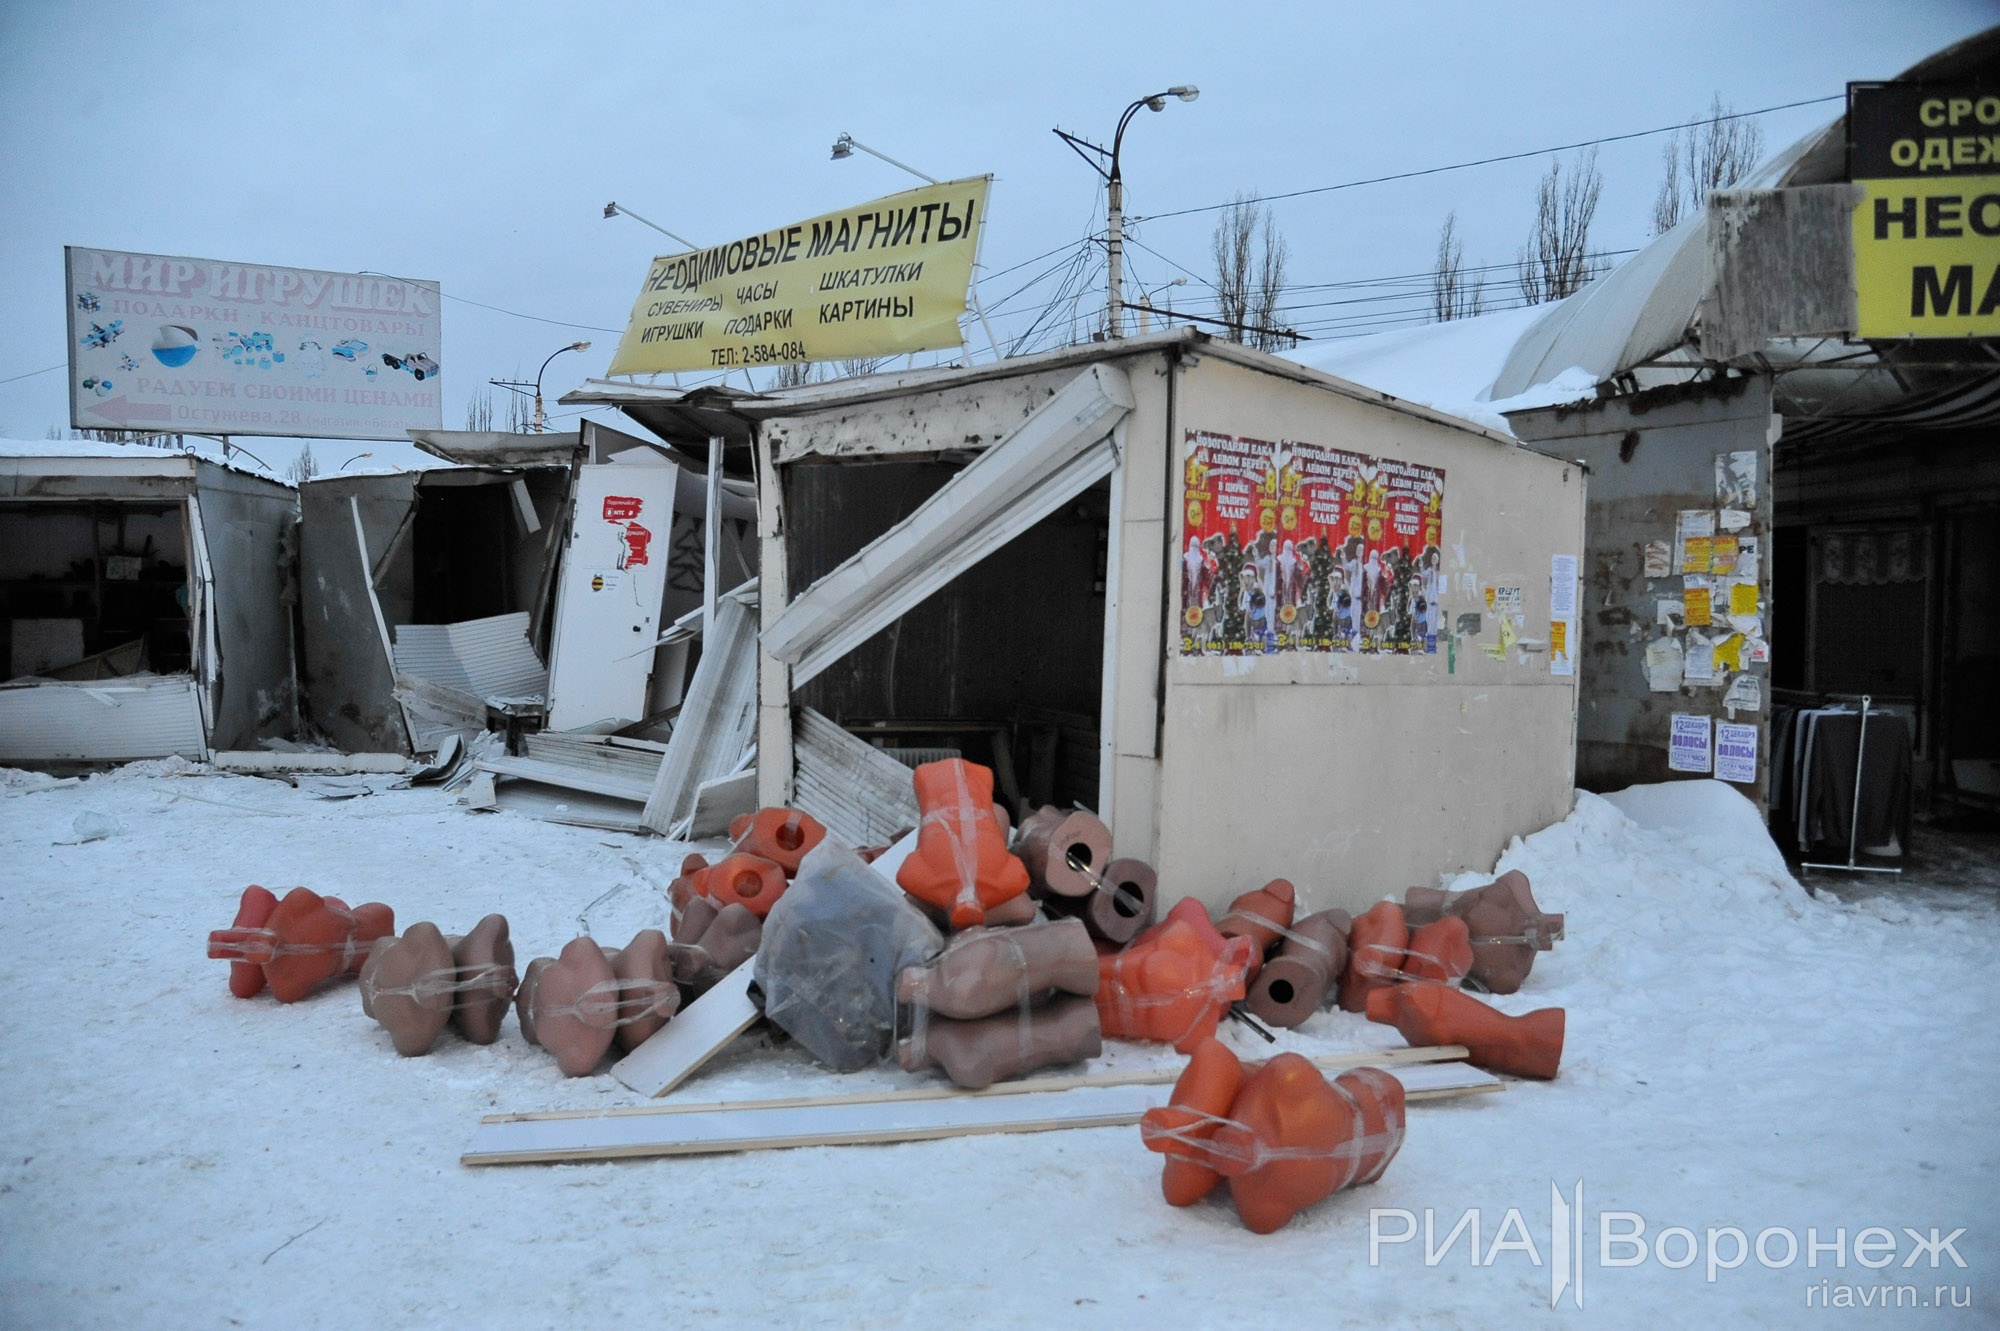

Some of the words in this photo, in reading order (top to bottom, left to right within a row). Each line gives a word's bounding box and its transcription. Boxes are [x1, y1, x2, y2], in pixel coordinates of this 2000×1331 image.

[1920, 97, 2000, 127] СРО
[642, 227, 800, 294] НЕОДИМОВЫЕ
[806, 199, 974, 259] МАГНИТЫ
[87, 253, 206, 298] МИР
[208, 264, 432, 318] ИГРУШЕК
[648, 294, 723, 318] СУВЕНИРЫ
[736, 280, 778, 306] ЧАСЫ
[820, 262, 924, 291] ШКАТУЛКИ
[112, 300, 239, 322] ПОДАРКИ
[260, 311, 424, 336] КАНЦТОВАРЫ
[642, 320, 703, 344] ИГРУШКИ
[724, 308, 792, 337] ПОДАРКИ
[820, 296, 914, 324] КАРТИНЫ
[711, 348, 739, 366] ТЕЛ:
[742, 340, 806, 364] 2-584-084
[136, 378, 236, 397] РАДУЕМ
[244, 384, 337, 402] СВОИМИ
[344, 389, 434, 408] ЦЕНАМИ
[1196, 435, 1249, 453] НОВОГОДНЯЯ
[1212, 453, 1240, 466] ЛЕВОМ
[1675, 720, 1683, 729] 12
[1721, 729, 1729, 739] 12
[1718, 744, 1754, 758] ВОЛОСЫ
